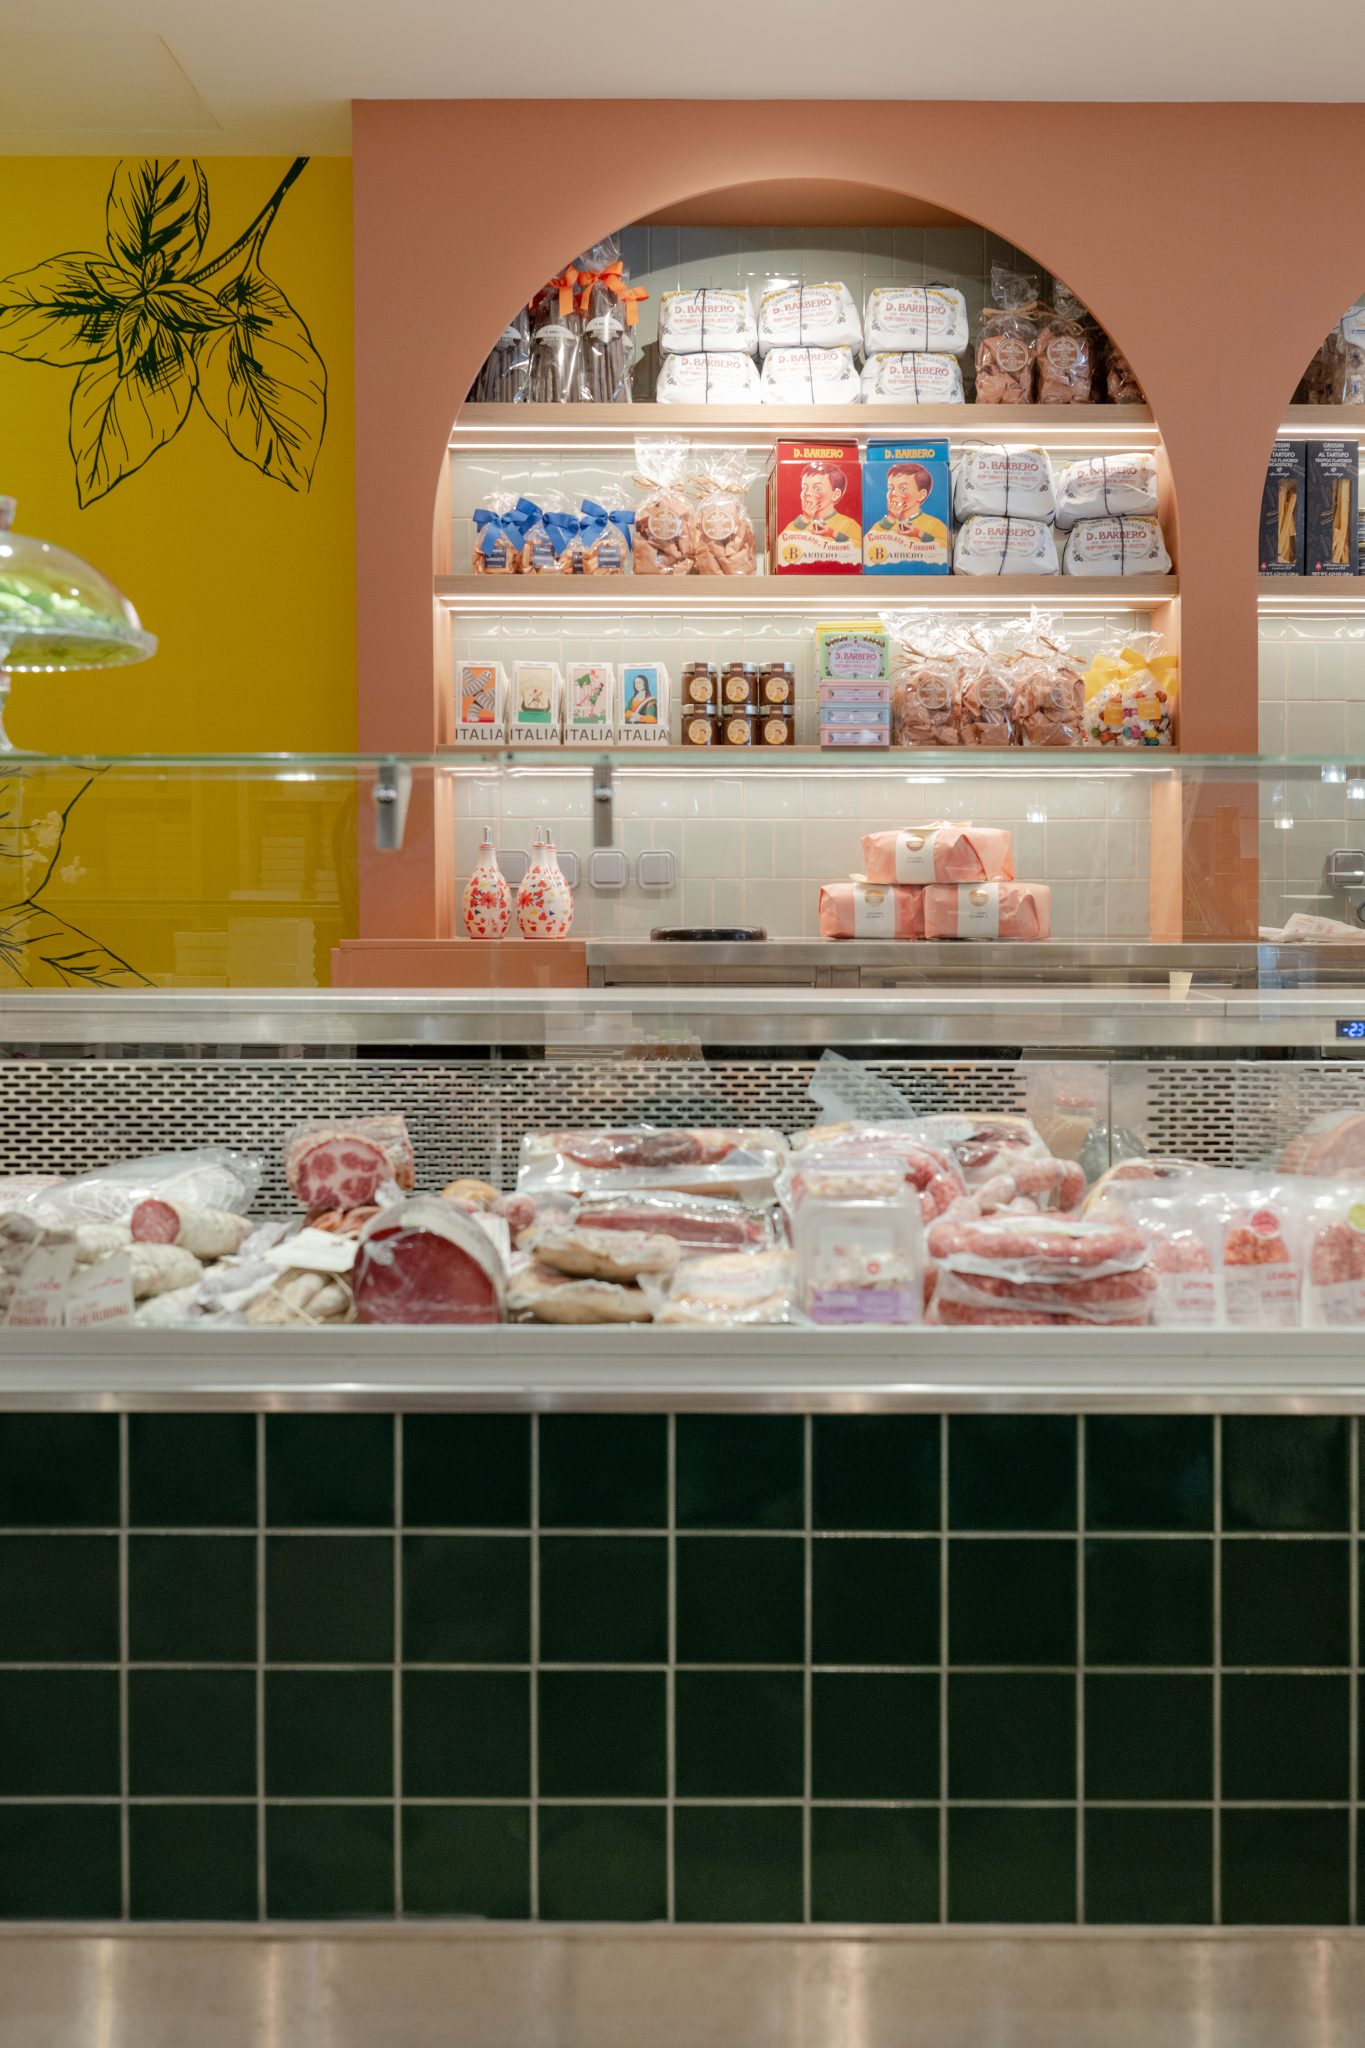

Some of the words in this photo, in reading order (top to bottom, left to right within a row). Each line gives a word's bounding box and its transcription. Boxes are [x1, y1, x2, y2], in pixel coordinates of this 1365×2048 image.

[675, 306, 686, 314] D.
[687, 305, 735, 314] BARBERO
[784, 298, 832, 311] BARBERO
[886, 302, 897, 311] D.
[898, 303, 946, 315] BARBERO
[791, 352, 839, 361] BARBERO
[681, 357, 692, 366] D.
[694, 357, 741, 369] BARBERO
[890, 366, 900, 375] D.
[902, 366, 949, 376] BARBERO
[793, 448, 803, 458] D.
[803, 448, 843, 458] BARBERO
[884, 449, 894, 459] D.
[895, 449, 935, 459] BARBERO
[979, 461, 990, 470] D.
[991, 461, 1039, 472] BARBERO
[975, 527, 986, 536] D.
[987, 527, 1036, 537] BARBERO
[1086, 532, 1098, 541] D.
[1099, 530, 1147, 540] BARBERO
[836, 652, 843, 660] D.
[844, 652, 877, 661] BARBERO
[455, 729, 505, 741] ITALIA
[510, 729, 559, 741] ITALIA
[565, 729, 613, 741] ITALIA
[618, 729, 667, 741] ITALIA
[1343, 1022, 1365, 1037] -23
